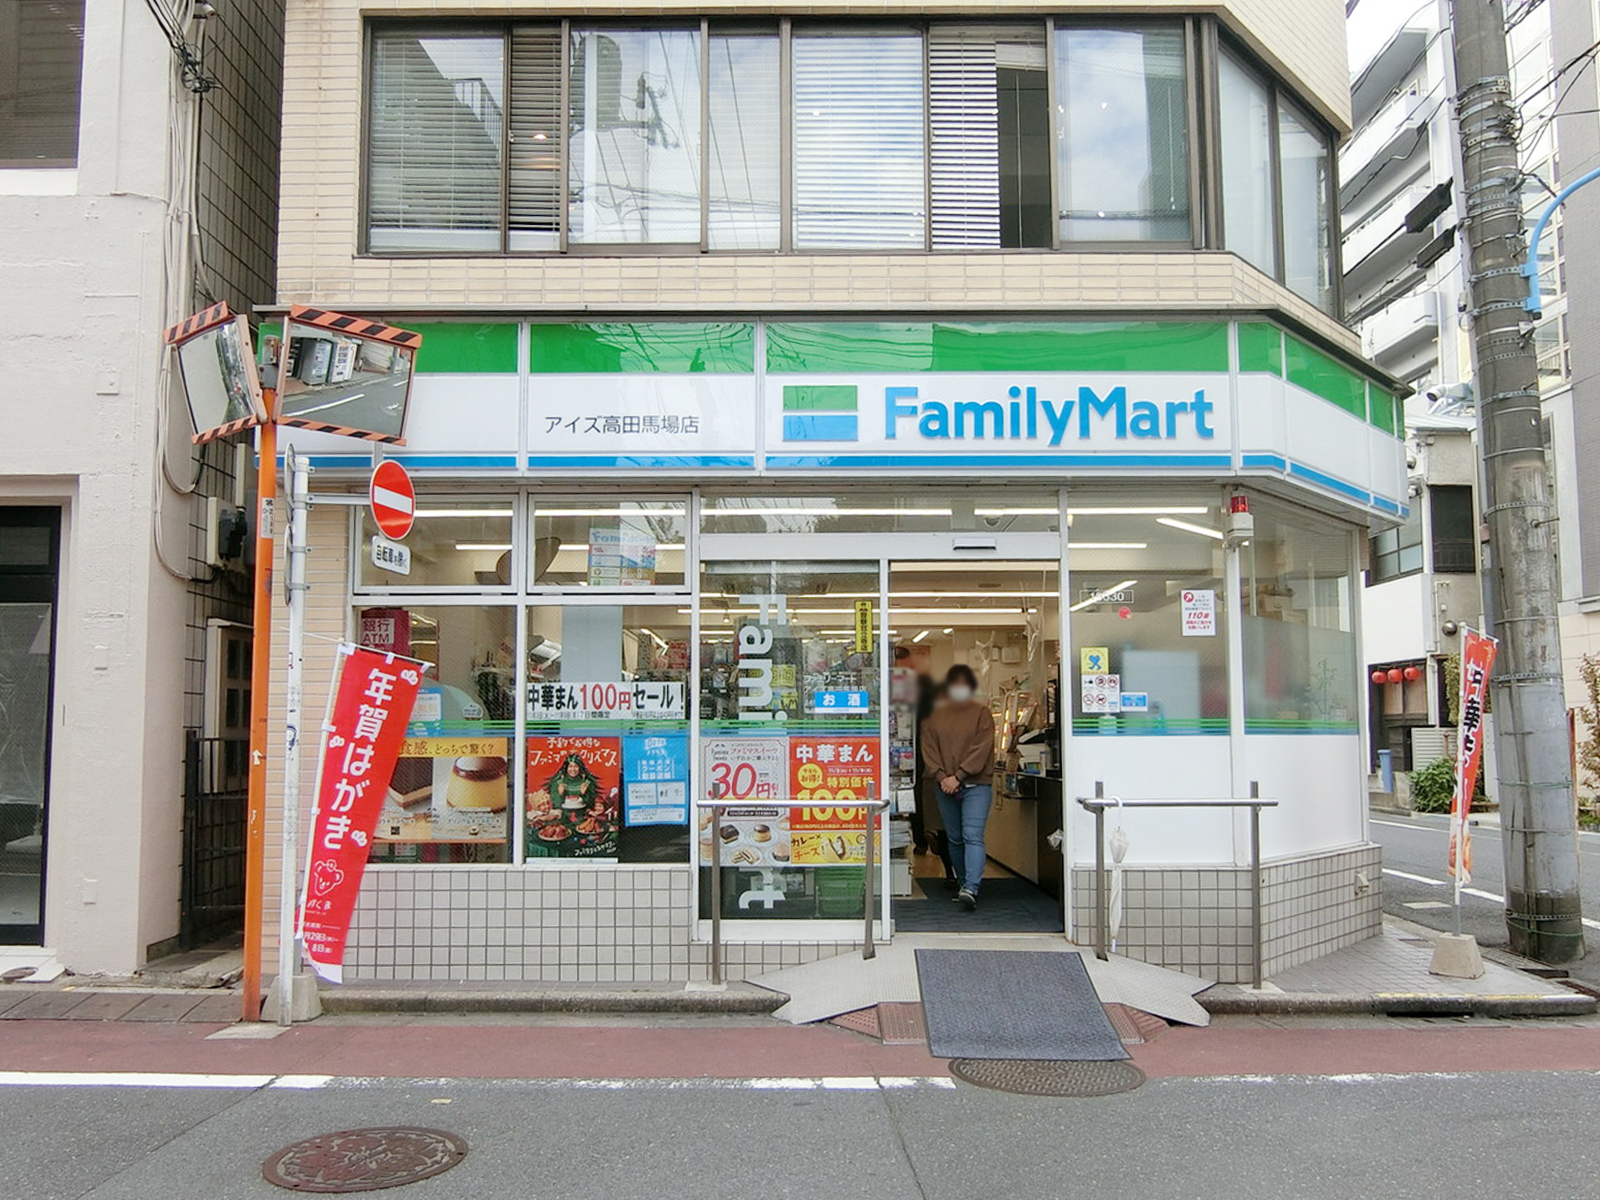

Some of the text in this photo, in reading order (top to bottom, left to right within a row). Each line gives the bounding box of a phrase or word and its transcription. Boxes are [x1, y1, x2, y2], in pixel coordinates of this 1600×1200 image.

[545, 414, 700, 434] アイズ高田馬場店
[885, 385, 1215, 447] FamilyMart
[362, 633, 390, 645] ATM
[822, 693, 861, 706] お酒
[323, 667, 397, 850] 年賀はがき
[796, 743, 874, 763] 中華まん
